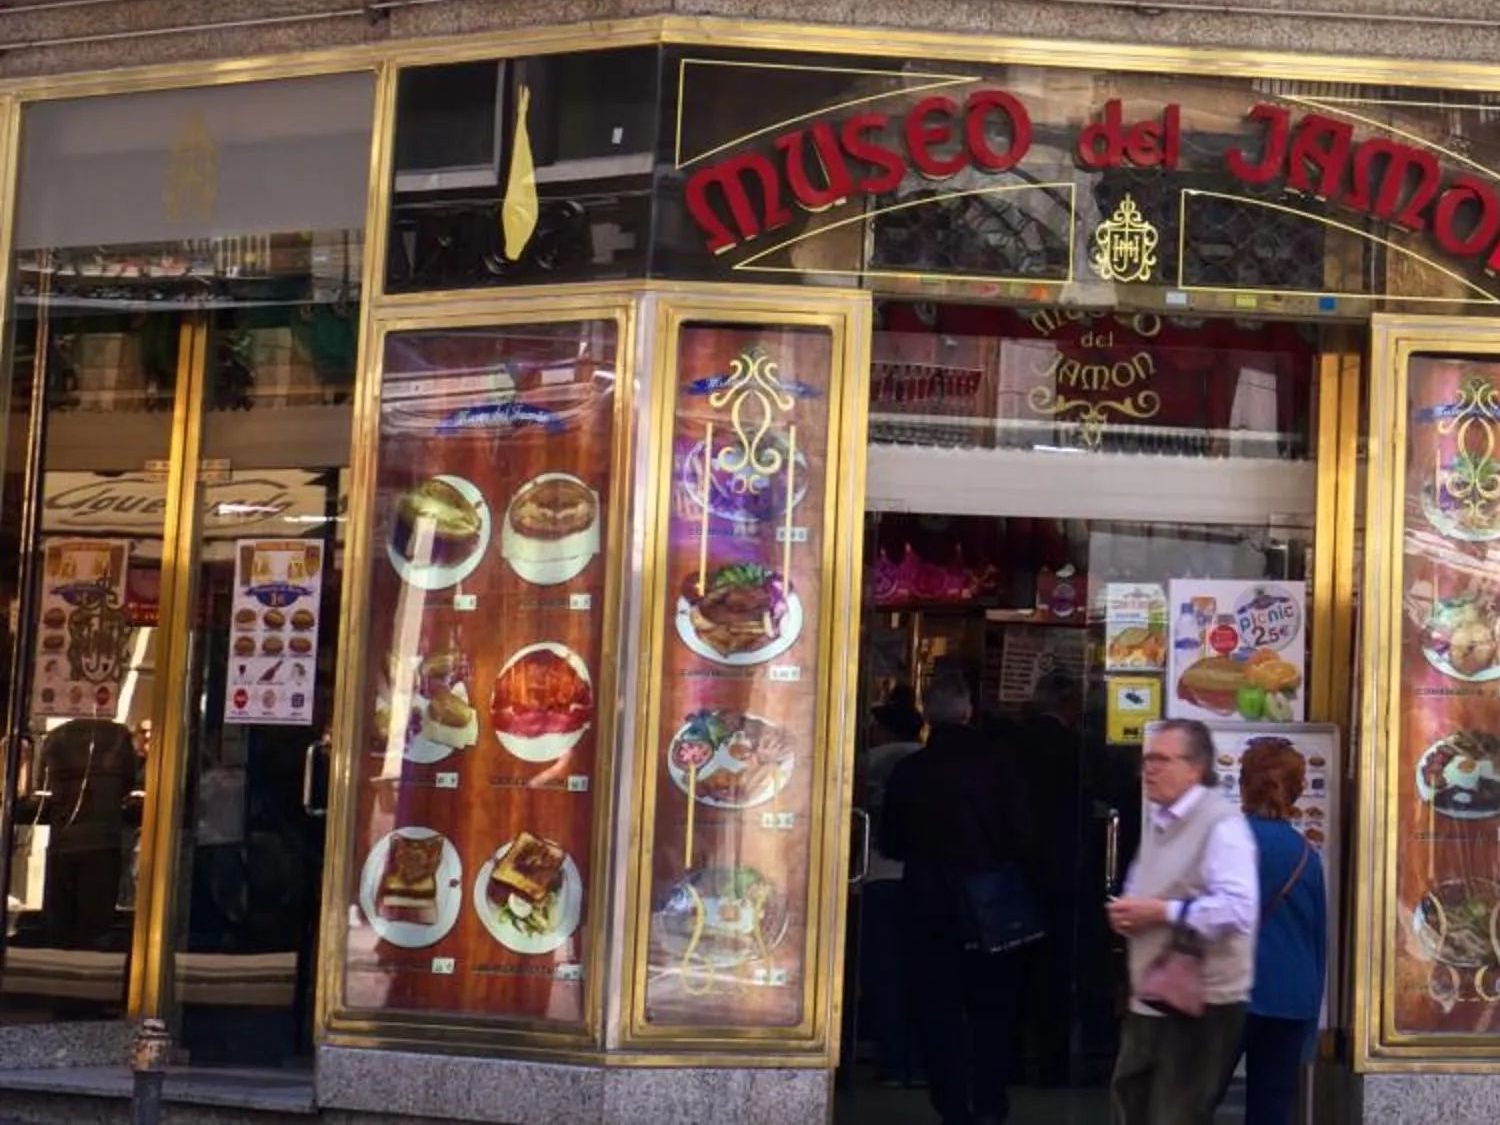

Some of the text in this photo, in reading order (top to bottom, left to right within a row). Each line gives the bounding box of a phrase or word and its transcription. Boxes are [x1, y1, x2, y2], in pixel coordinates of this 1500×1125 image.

[684, 89, 1034, 254] MUSEO
[1076, 97, 1181, 170] del
[1080, 330, 1114, 348] del
[1030, 350, 1157, 391] JAMON
